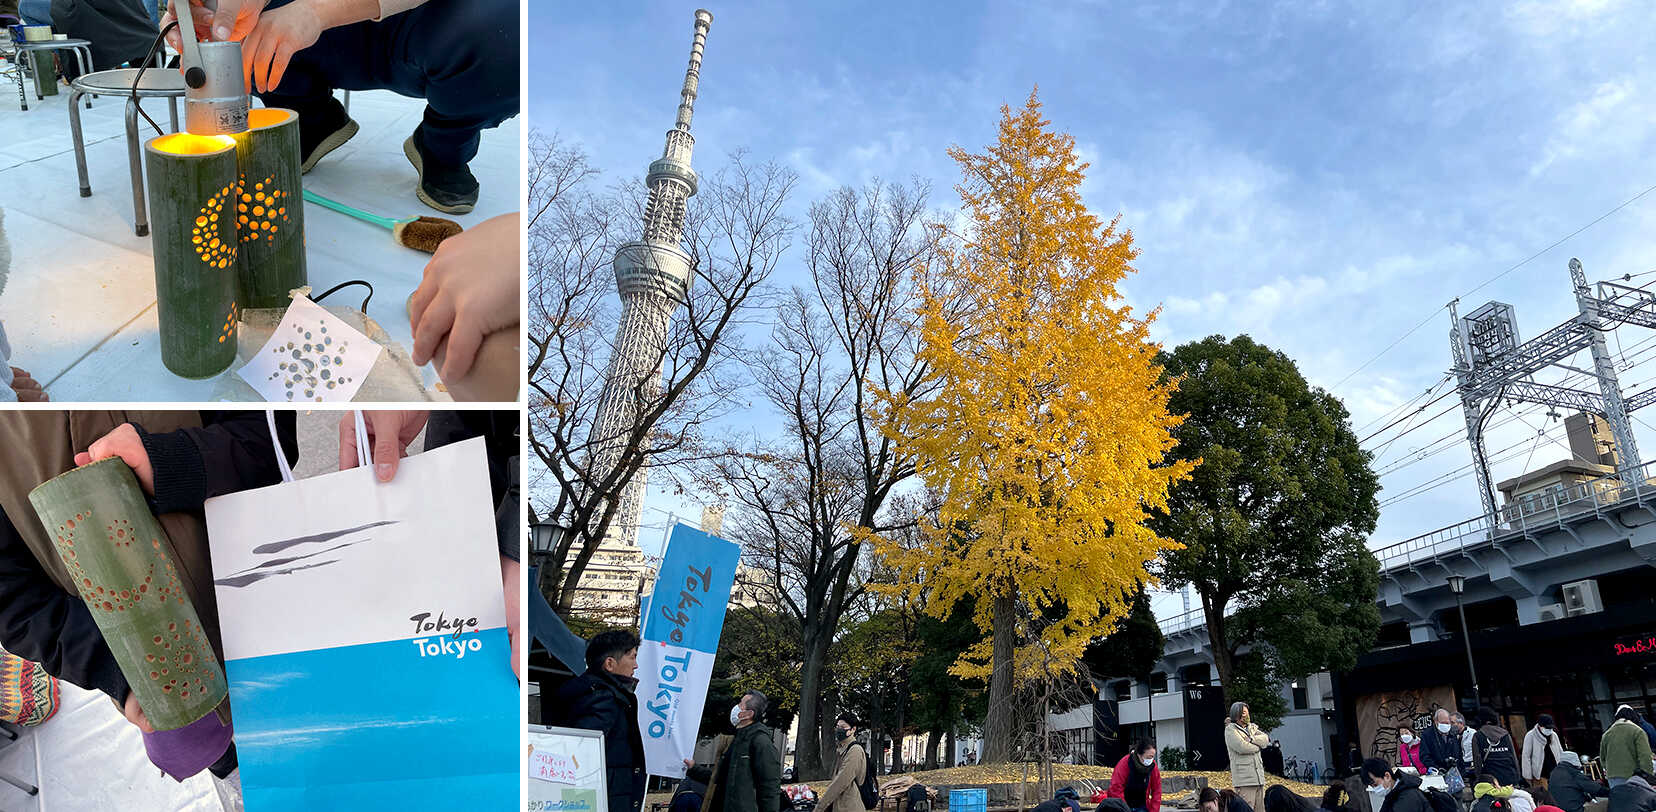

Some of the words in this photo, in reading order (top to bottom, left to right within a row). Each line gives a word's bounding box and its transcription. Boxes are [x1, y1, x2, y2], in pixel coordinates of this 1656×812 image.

[661, 565, 712, 643] Tokyo
[409, 608, 479, 639] Tokyo
[412, 636, 483, 659] Tokyo
[646, 651, 692, 738] Tokyo
[1190, 690, 1202, 700] W6
